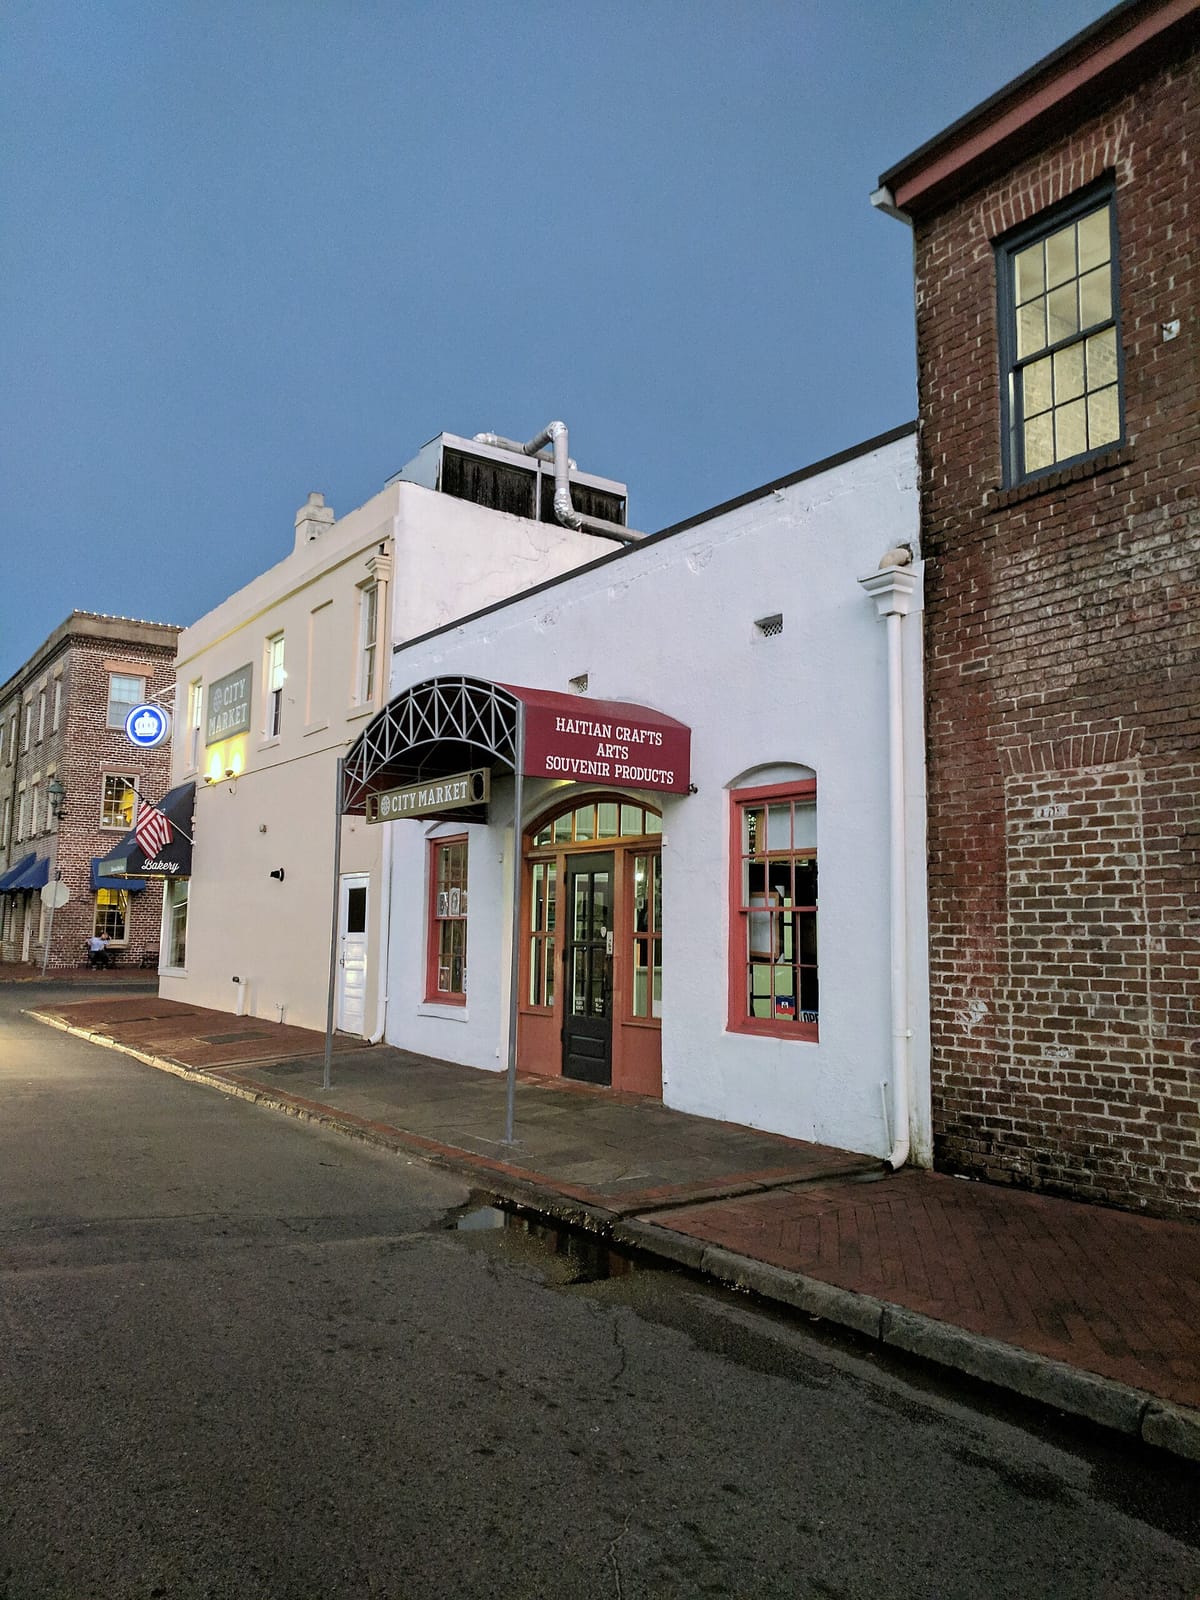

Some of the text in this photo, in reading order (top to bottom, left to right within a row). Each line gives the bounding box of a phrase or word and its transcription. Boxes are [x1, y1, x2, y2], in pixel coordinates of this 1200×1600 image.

[224, 678, 246, 706] CITY
[208, 702, 247, 737] MARKET
[555, 717, 663, 746] HAITIAN CRAFTS
[596, 743, 629, 760] ARTS
[545, 755, 674, 785] SOUVENIR PRODUCTS
[391, 781, 468, 812] CITY MARKET
[141, 858, 180, 874] Bakery
